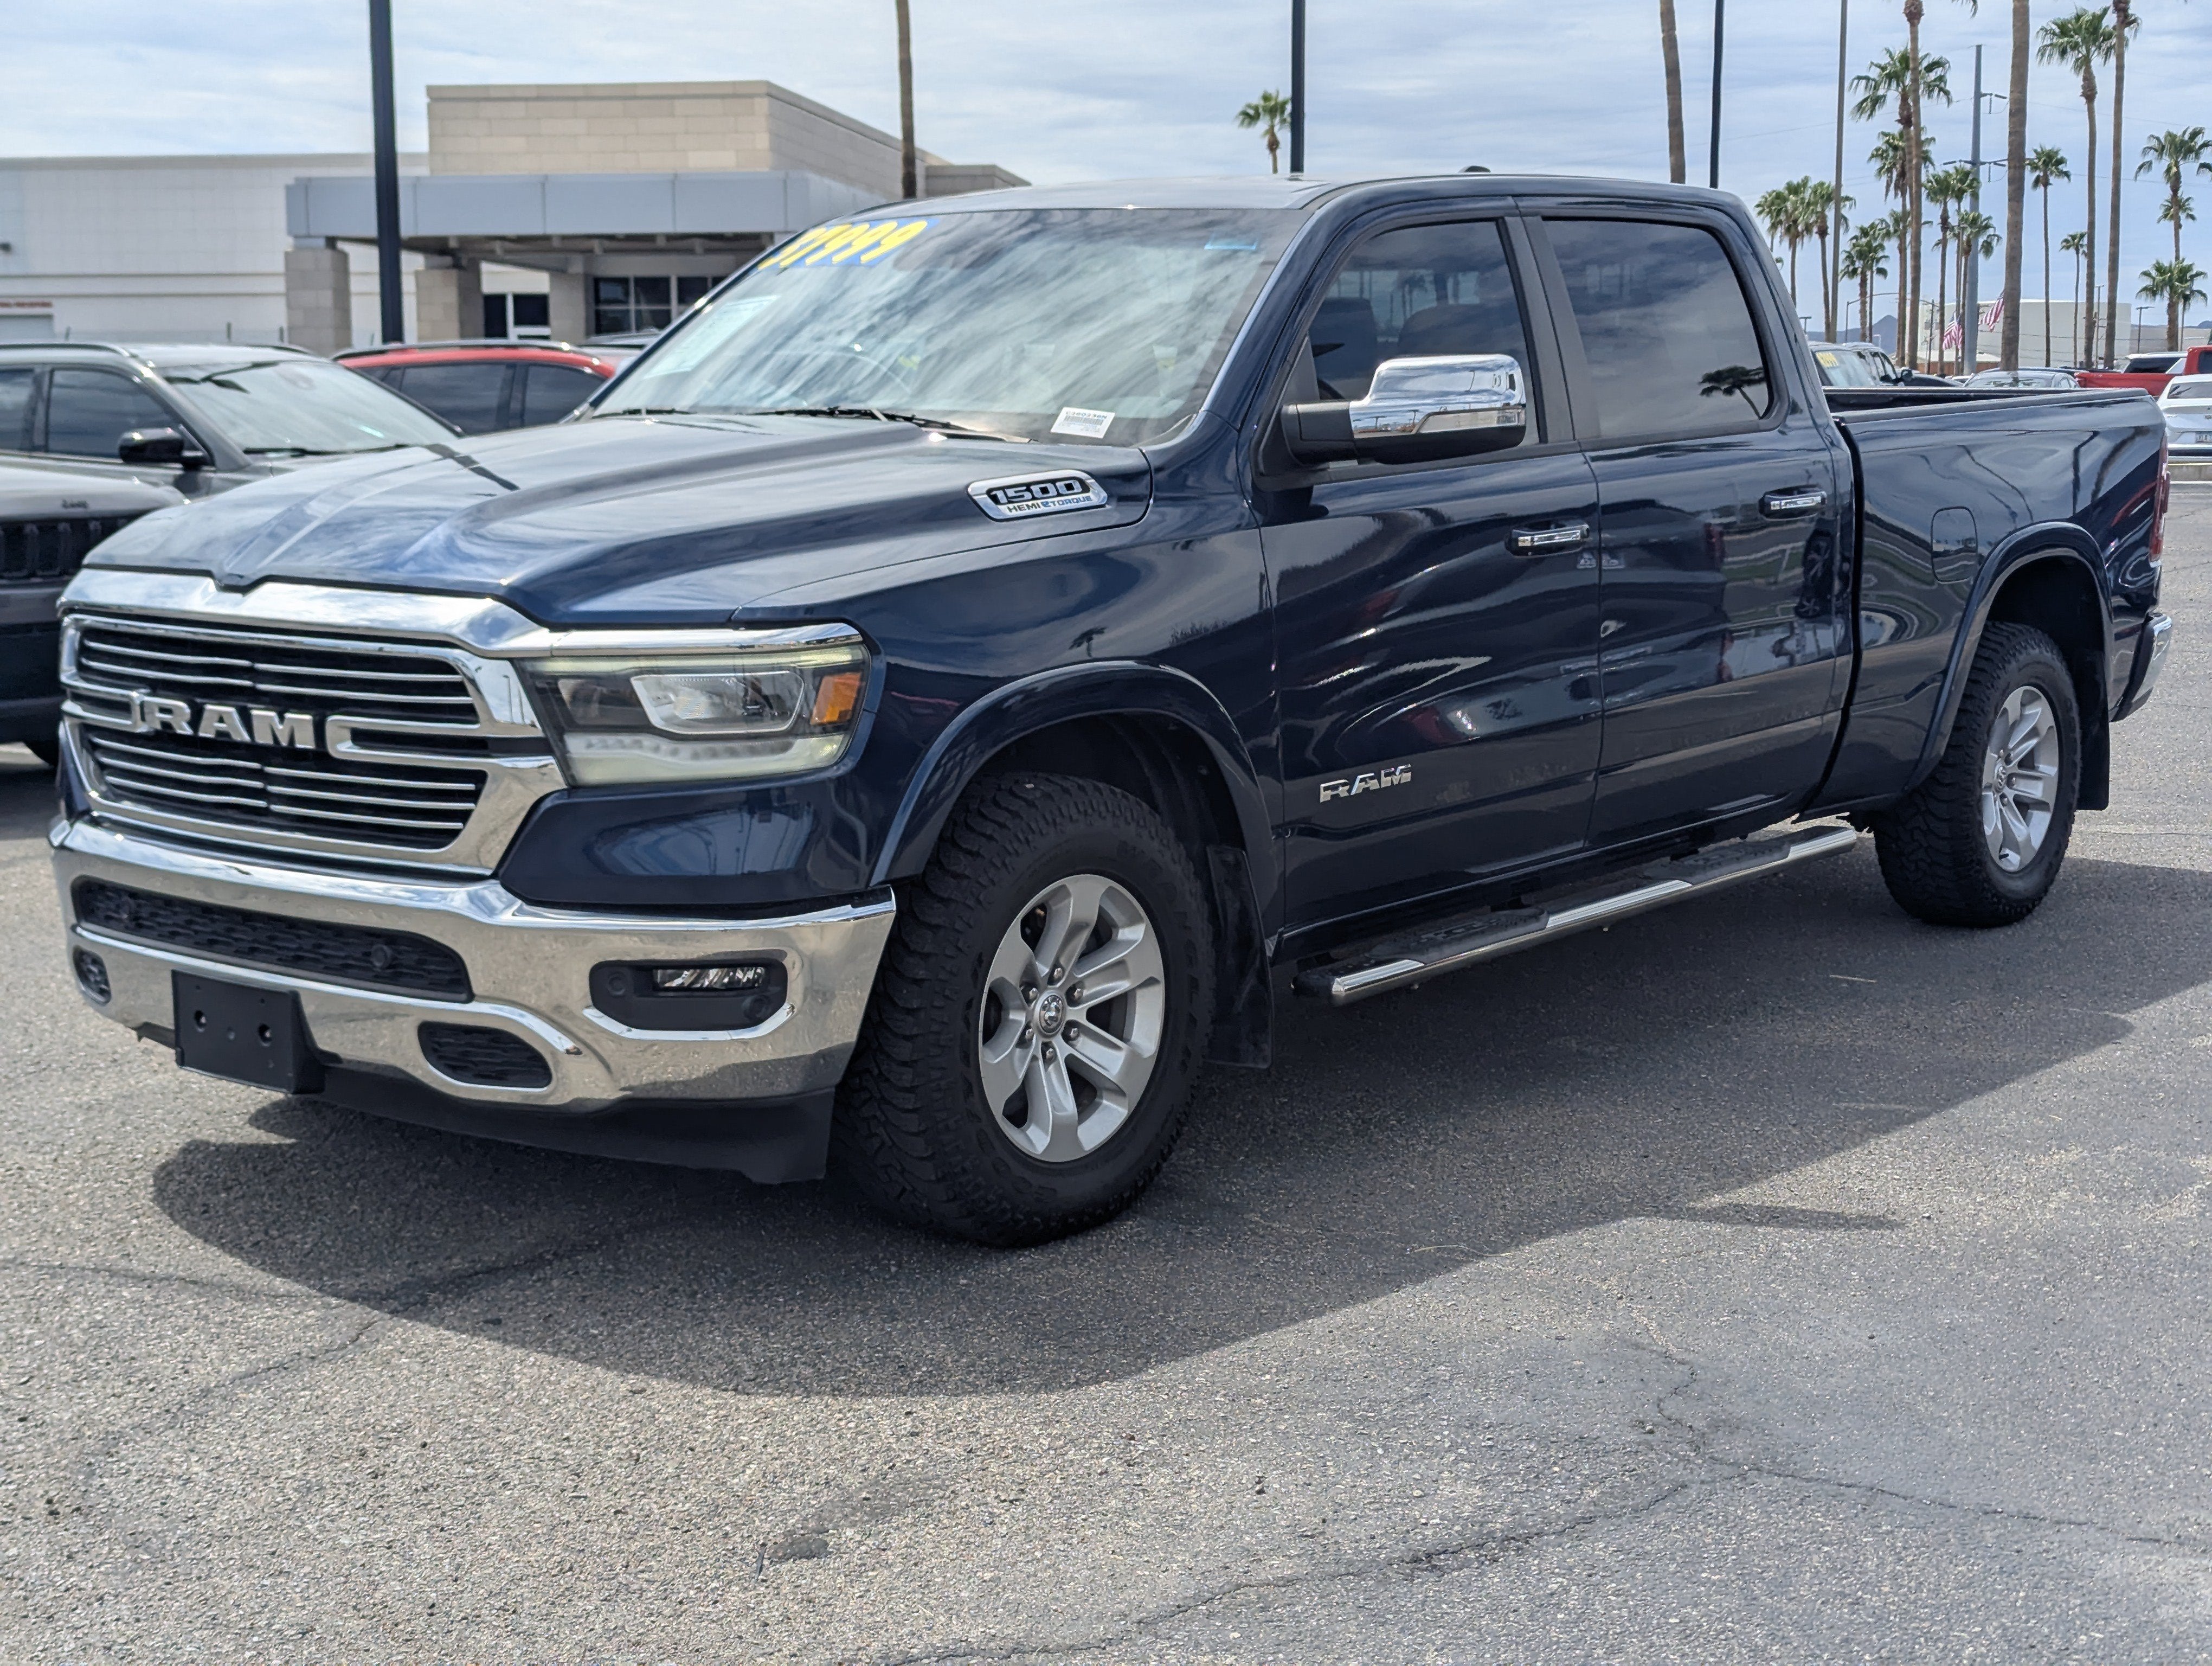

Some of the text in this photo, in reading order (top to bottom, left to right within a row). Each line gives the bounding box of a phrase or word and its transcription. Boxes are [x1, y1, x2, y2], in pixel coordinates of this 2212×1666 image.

[992, 479, 1082, 503] 1500
[1007, 502, 1041, 513] HEMI
[139, 696, 316, 749] RAM
[1320, 764, 1411, 803] RAM
